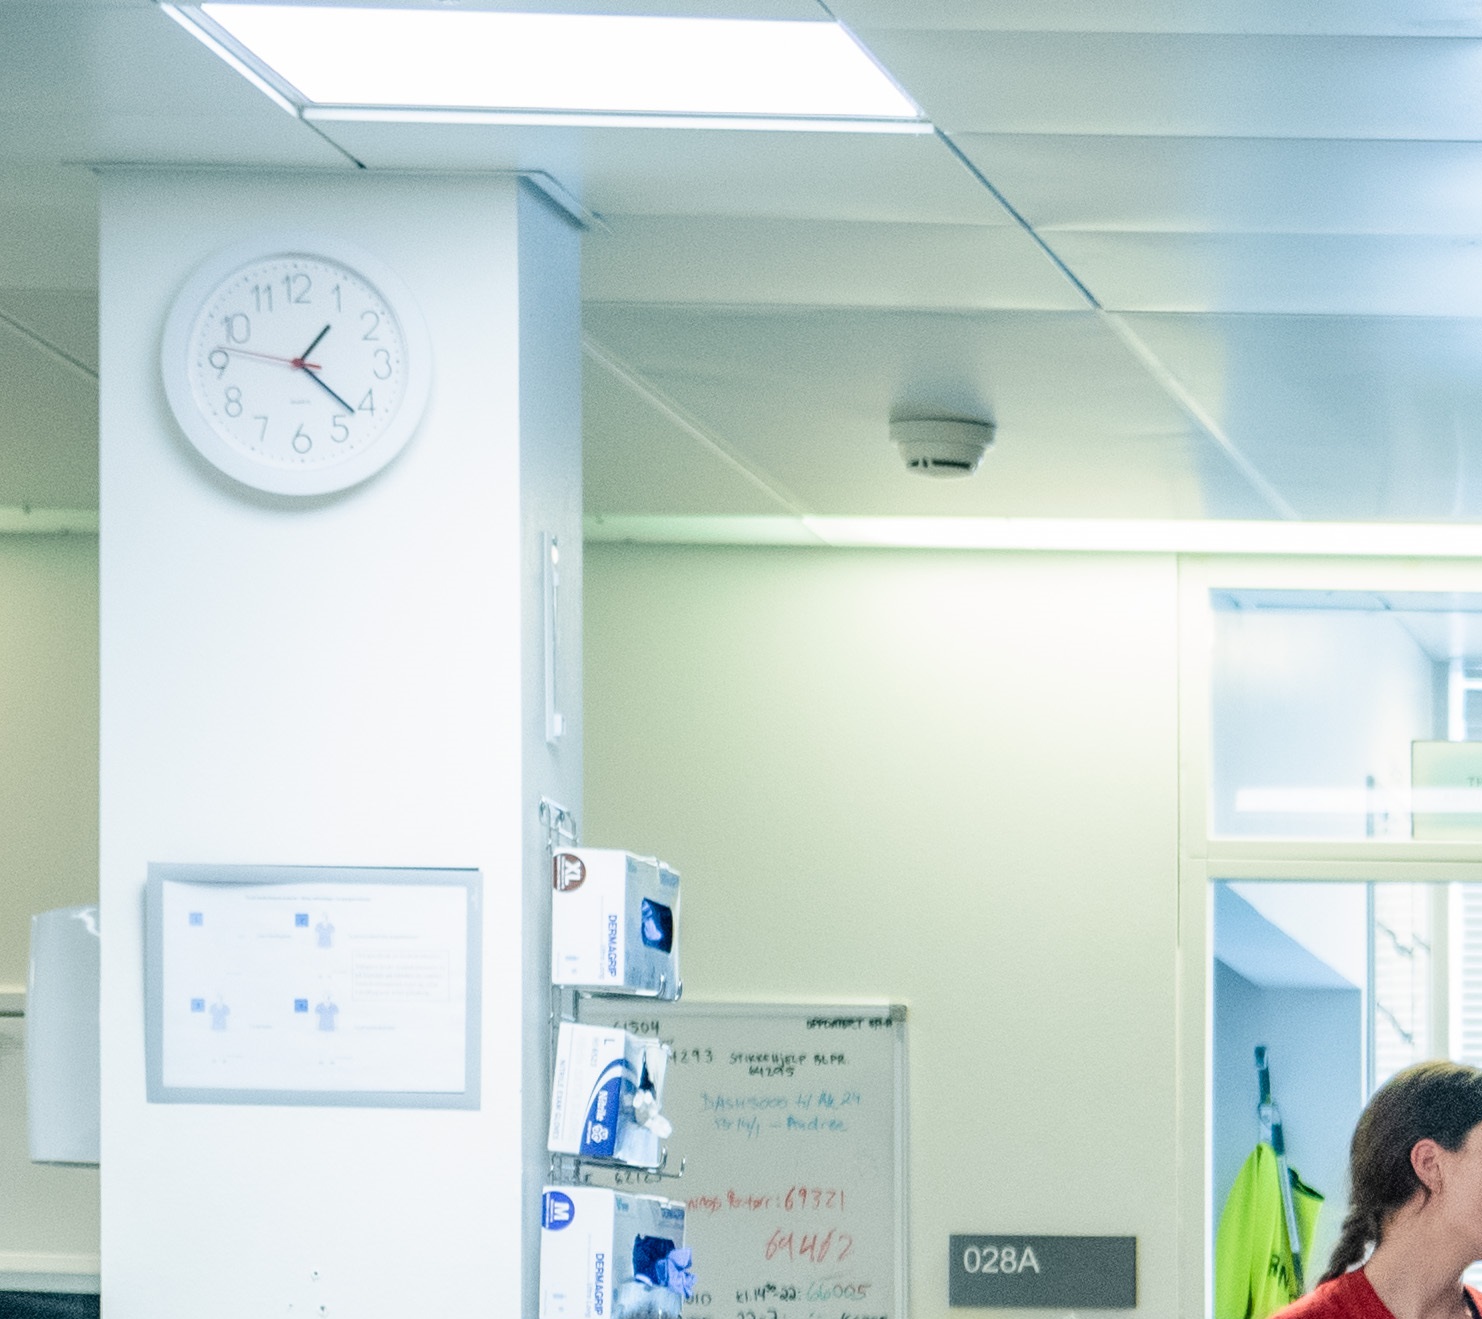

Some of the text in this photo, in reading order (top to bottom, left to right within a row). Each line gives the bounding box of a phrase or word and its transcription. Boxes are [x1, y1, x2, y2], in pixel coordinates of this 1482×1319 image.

[251, 283, 273, 313] 11
[282, 273, 312, 304] 12
[332, 283, 341, 313] 1
[222, 313, 250, 344] 10
[360, 310, 380, 341] 2
[208, 349, 230, 380] 9
[373, 349, 392, 380] 3
[225, 386, 243, 418] 8
[357, 388, 376, 417] 4
[253, 416, 269, 442] 7
[292, 423, 313, 454] 6
[330, 414, 349, 443] 5
[564, 859, 582, 887] XL
[607, 914, 618, 977] DERMAGRIP
[554, 1201, 570, 1221] M
[784, 1185, 846, 1212] 69321
[962, 1245, 1041, 1274] 028A
[594, 1252, 605, 1316] DERMAGRIP
